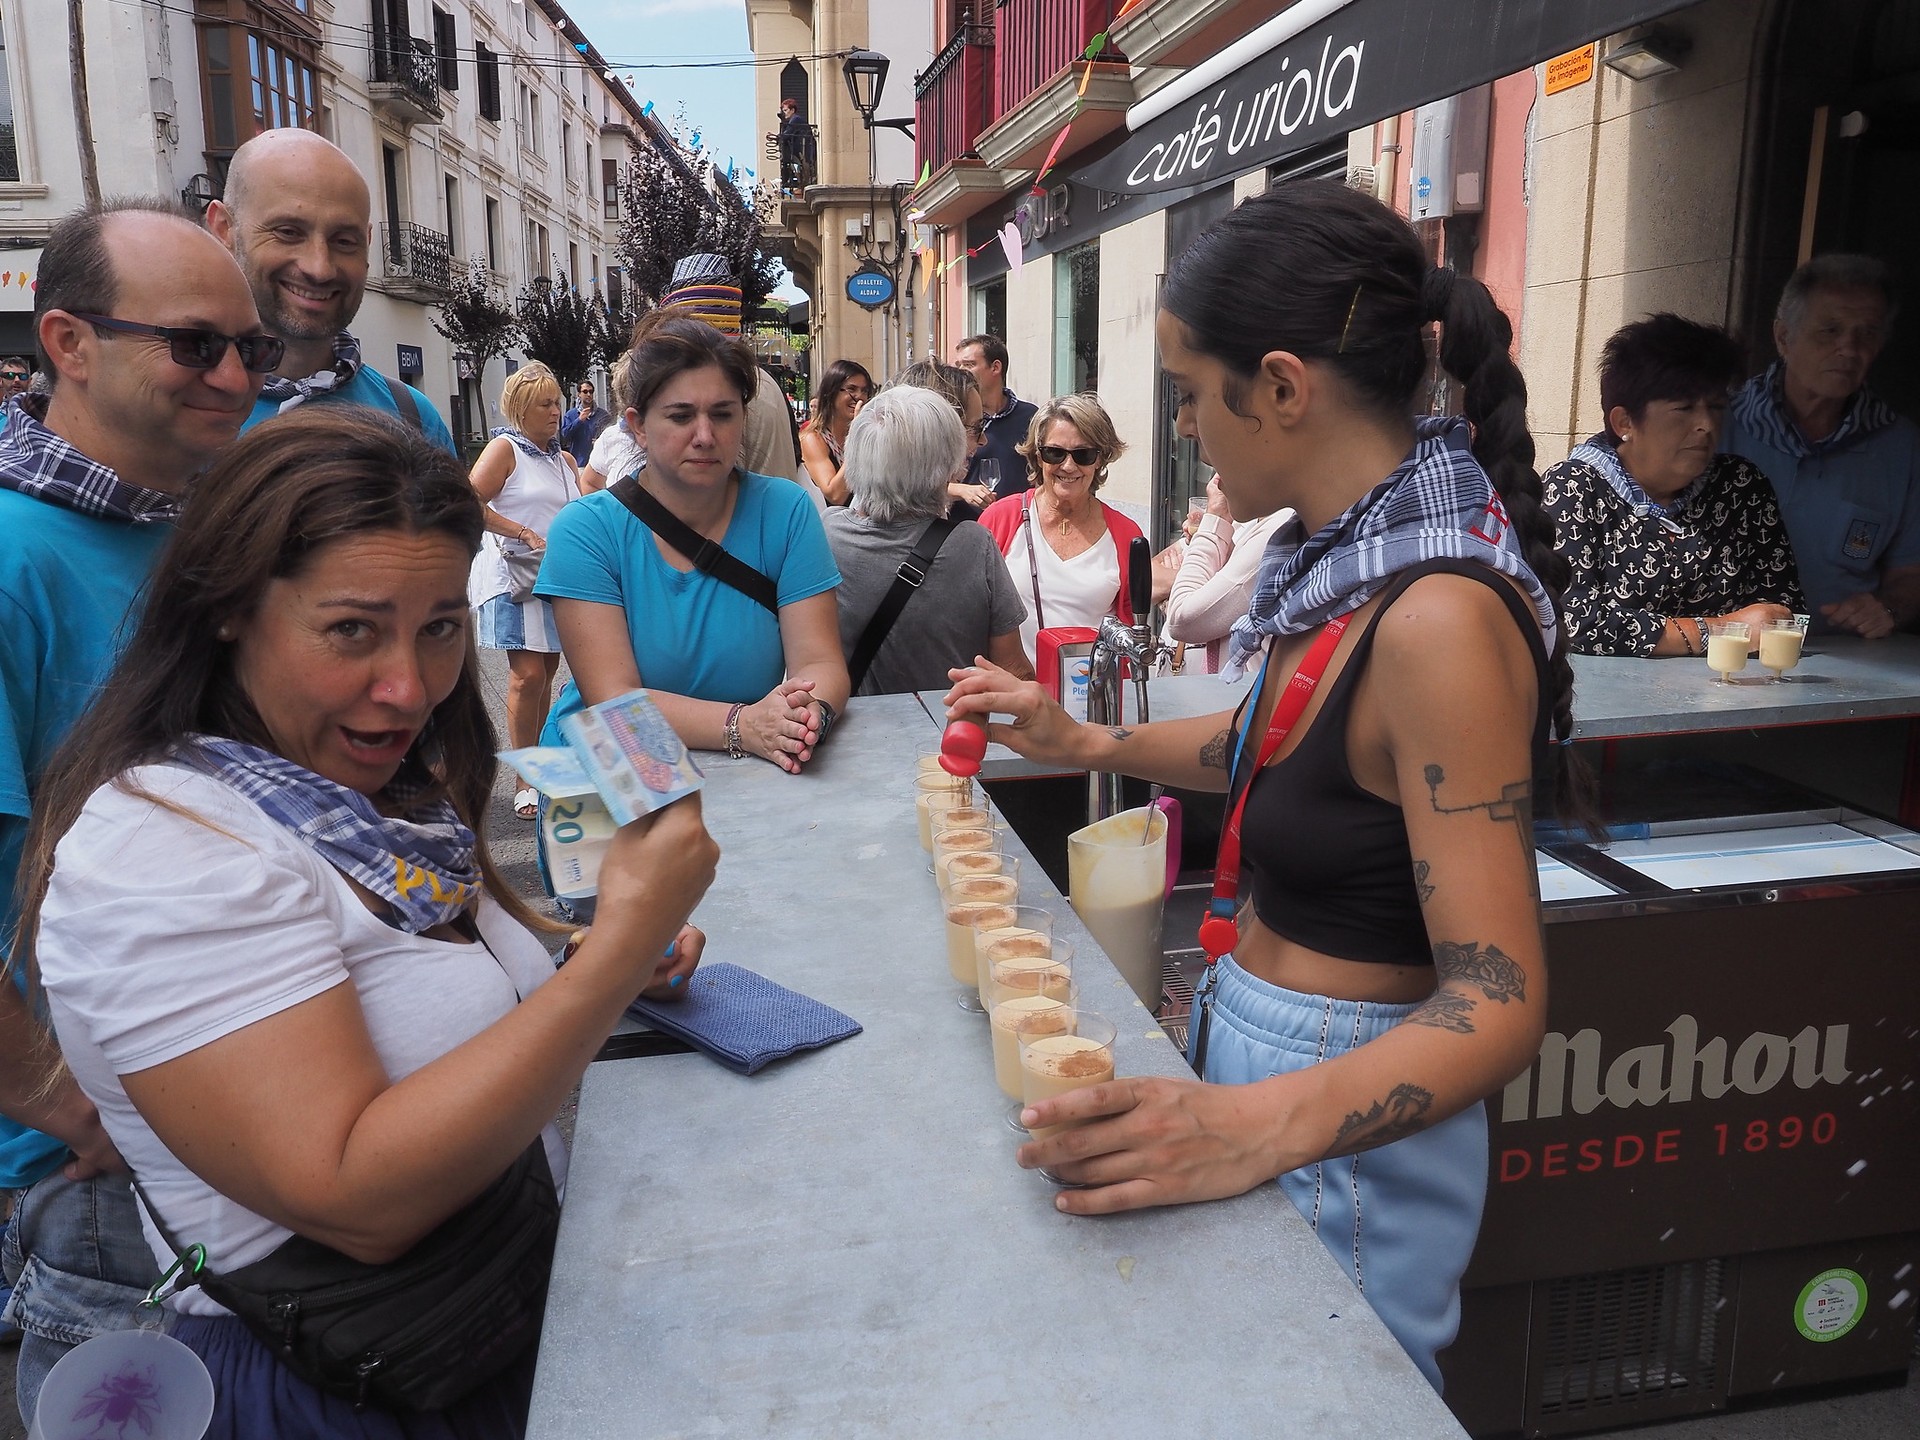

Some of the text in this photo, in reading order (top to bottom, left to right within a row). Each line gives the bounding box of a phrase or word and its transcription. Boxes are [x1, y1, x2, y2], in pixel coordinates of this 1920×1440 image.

[1548, 75, 1556, 84] de
[1557, 64, 1588, 80] imágenes
[1549, 55, 1581, 74] Grabación
[1126, 35, 1365, 187] café uriola
[401, 352, 420, 367] BBVA
[551, 801, 584, 844] 20
[571, 858, 583, 882] EURO
[1500, 1013, 1854, 1124] Mahou
[1500, 1112, 1838, 1183] DESDE 1890
